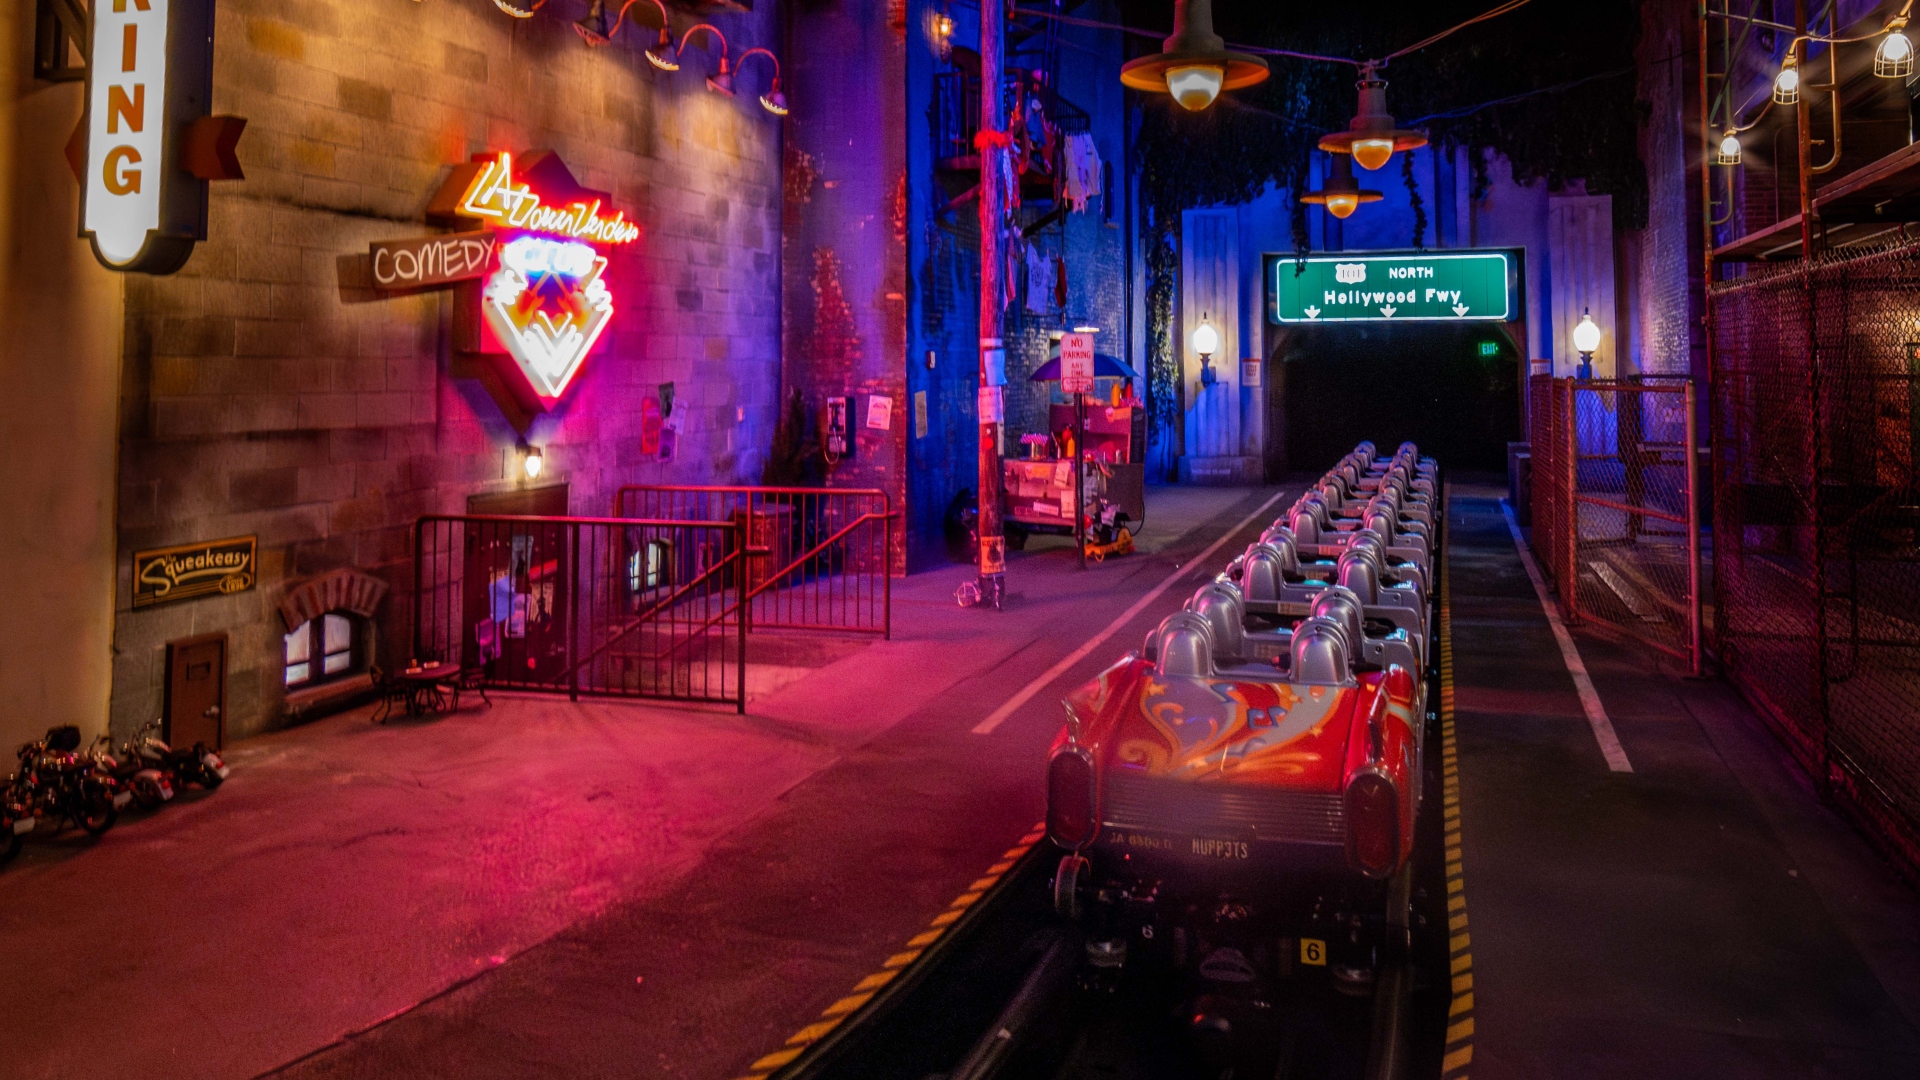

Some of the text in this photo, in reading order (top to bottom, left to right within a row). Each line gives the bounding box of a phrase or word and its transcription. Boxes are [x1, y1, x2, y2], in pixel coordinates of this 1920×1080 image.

[103, 0, 151, 196] ING
[374, 237, 496, 284] COMEDY
[1389, 266, 1434, 279] NORTH
[1324, 288, 1461, 307] Hollywood Fwy
[1070, 338, 1083, 348] NO
[1481, 343, 1496, 355] EXIT
[1063, 351, 1091, 360] PARKING
[140, 548, 250, 597] Squeakeasy
[1142, 924, 1154, 939] 6
[1306, 943, 1320, 962] 6
